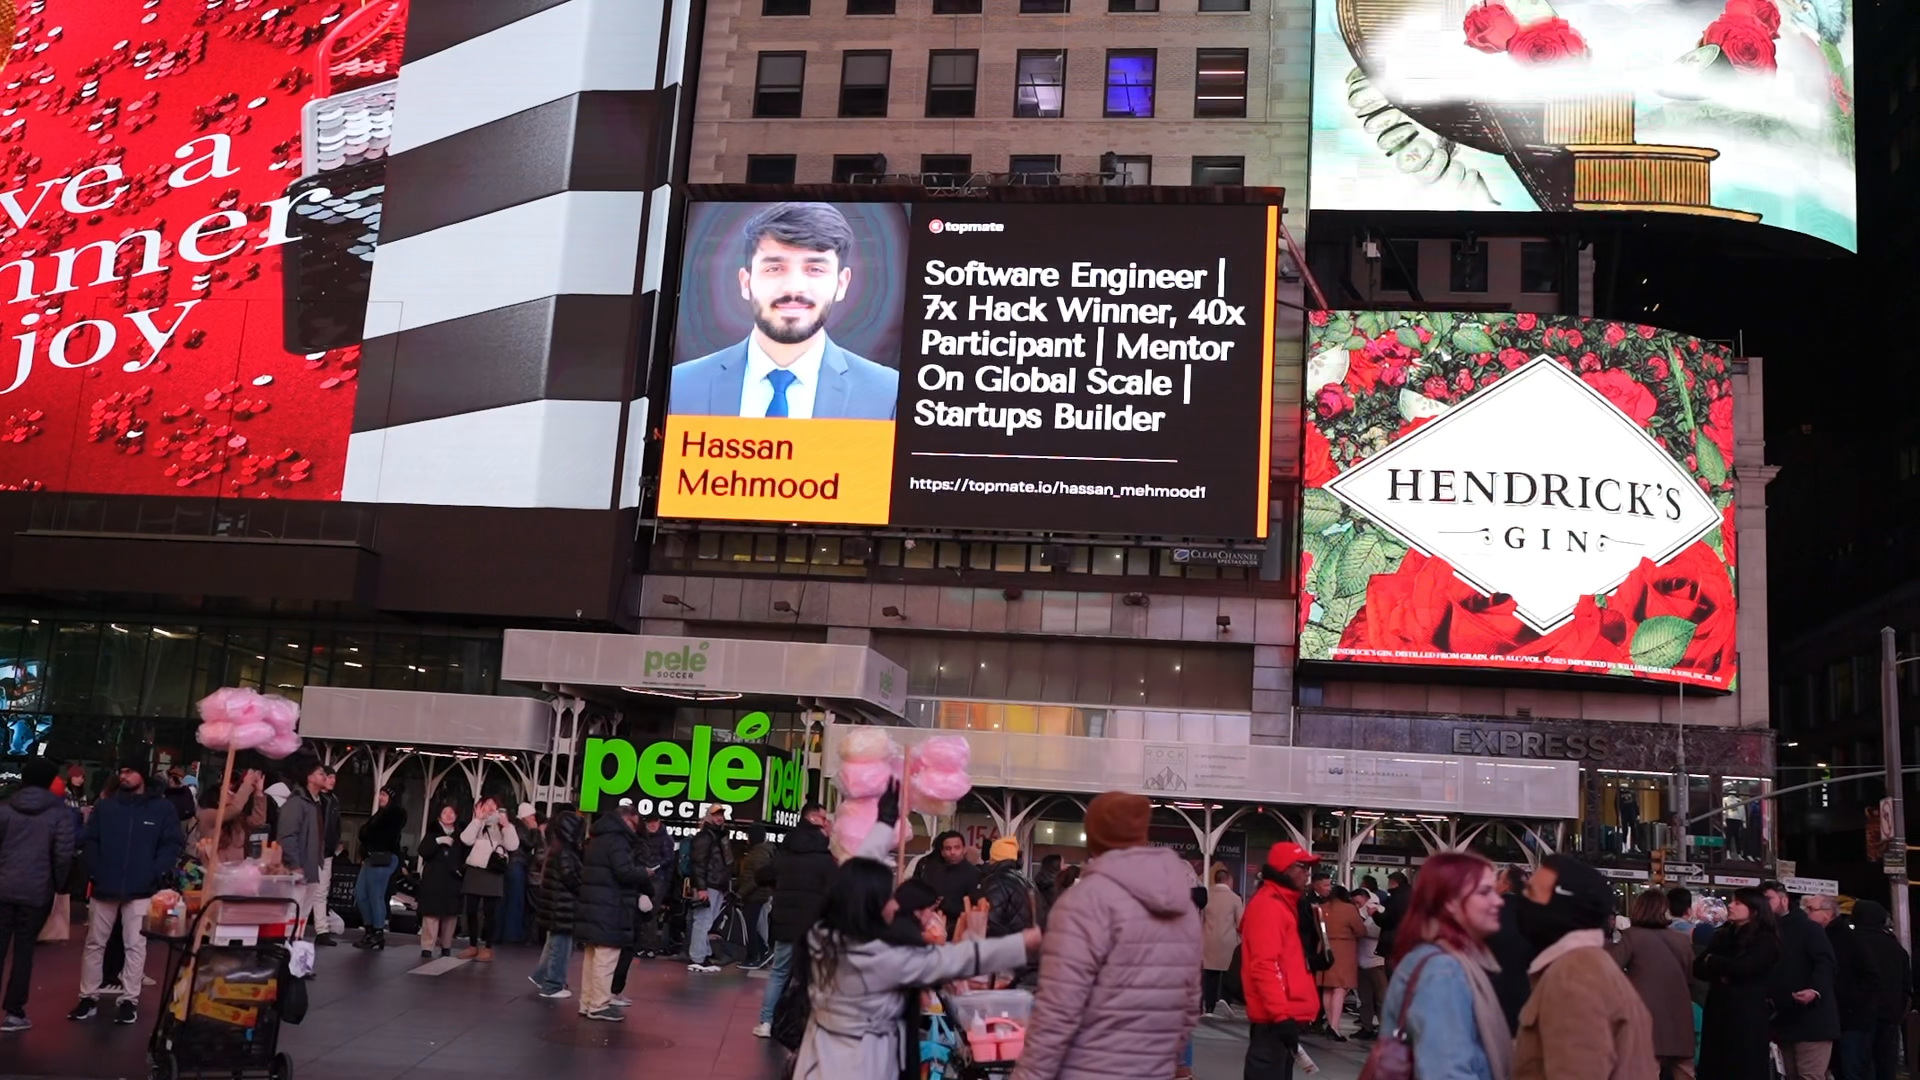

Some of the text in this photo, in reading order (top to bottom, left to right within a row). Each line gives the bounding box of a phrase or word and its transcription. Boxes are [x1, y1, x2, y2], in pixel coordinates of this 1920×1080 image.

[168, 133, 241, 189] a
[945, 221, 1005, 233] topmate
[924, 259, 1060, 287] Software
[1071, 261, 1208, 296] Engineer
[922, 294, 1246, 329] 7x Hack Winner, 40x
[0, 299, 202, 395] joy
[921, 329, 1086, 365] Participant
[1116, 332, 1235, 361] Mentor
[917, 363, 964, 391] On
[975, 365, 1077, 394] Global
[1086, 367, 1173, 396] Scale
[913, 399, 1166, 436] Startups Builder
[681, 430, 794, 460] Hassan
[677, 468, 840, 500] Mehmood
[909, 476, 1206, 499] https://topmate.io/hassan_mehmood1
[1387, 468, 1682, 521] HENDRICK'S
[1504, 526, 1588, 553] GIN
[644, 641, 710, 677] pelé
[1328, 647, 1376, 657] HENDRICK'S
[1395, 650, 1435, 659] DISTILLED
[1436, 652, 1459, 660] FROM
[1567, 659, 1607, 668] IMPORTED
[657, 671, 694, 679] SOCCER
[1145, 749, 1185, 759] ROCK
[1453, 728, 1609, 760] EXPRESS
[579, 711, 771, 812] pelé
